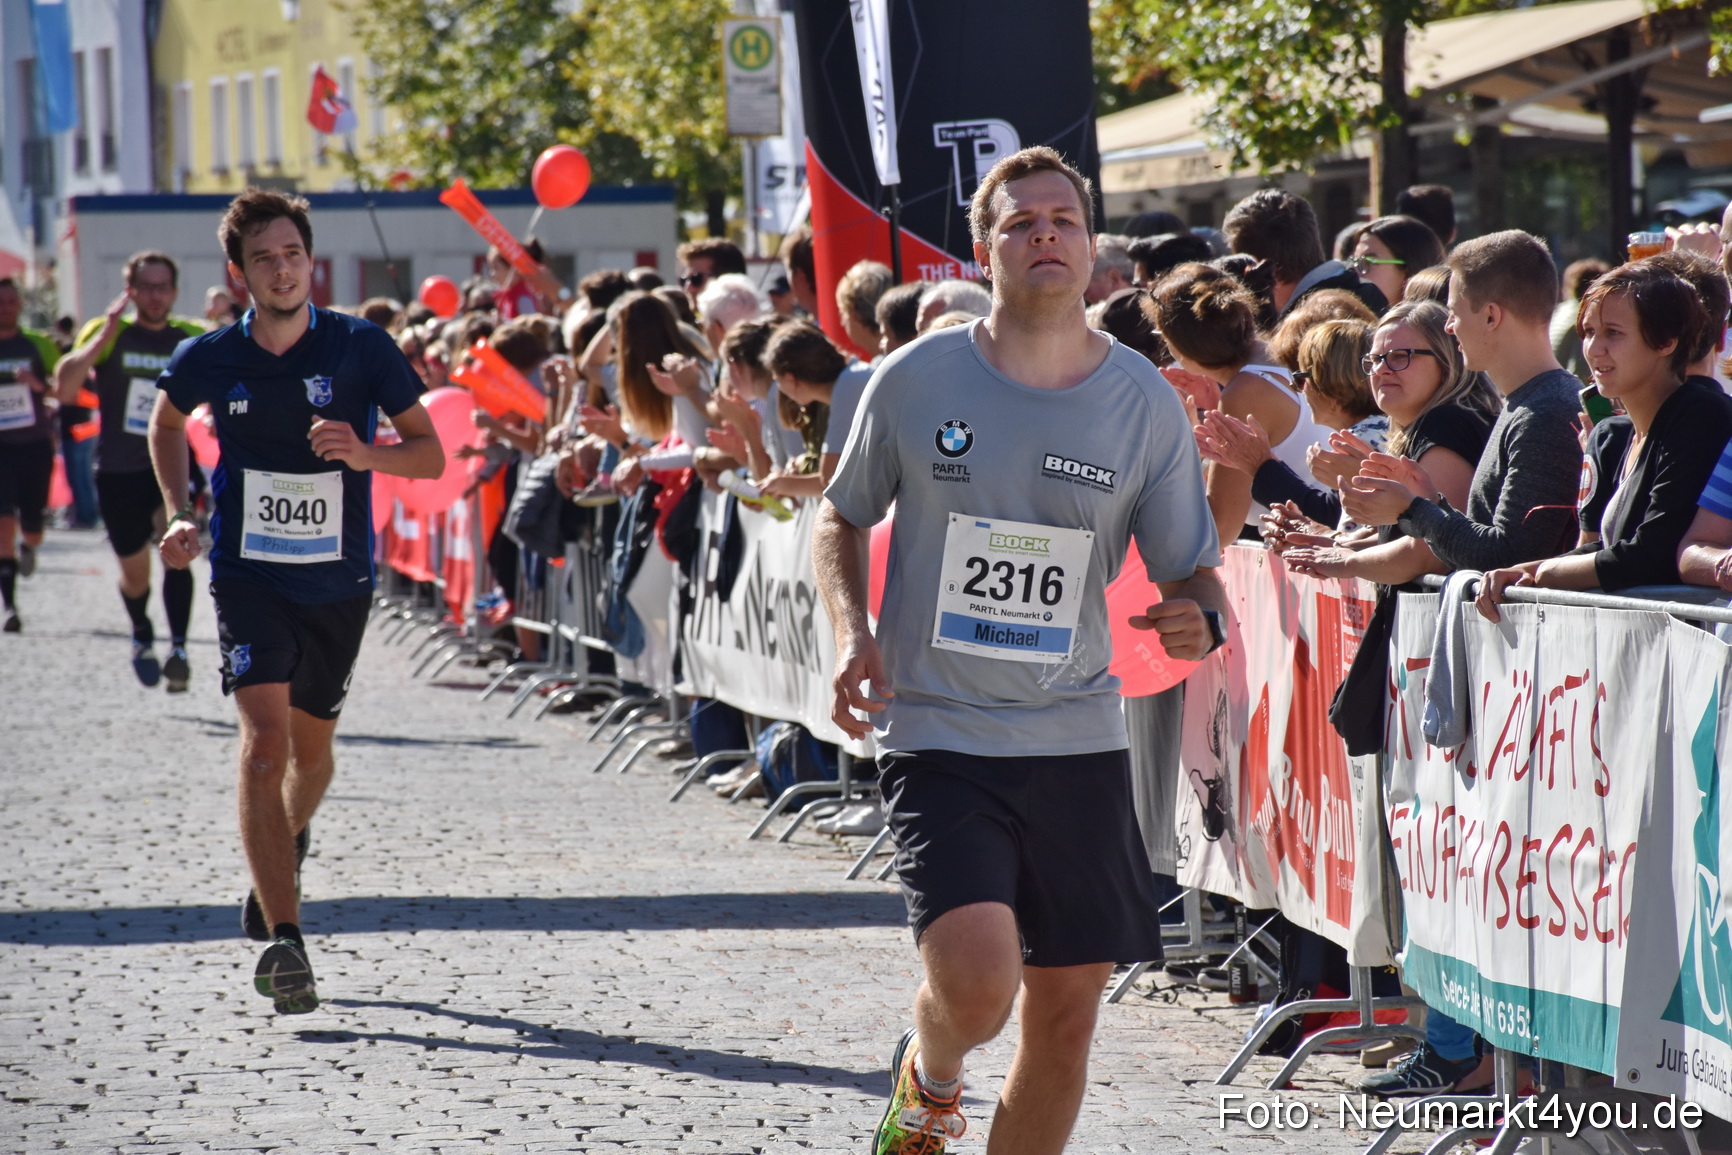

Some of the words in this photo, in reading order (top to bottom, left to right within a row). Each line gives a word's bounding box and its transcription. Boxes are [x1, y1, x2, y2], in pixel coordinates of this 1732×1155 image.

[917, 262, 957, 281] THE
[229, 400, 249, 415] PM
[940, 420, 973, 436] BMW
[932, 463, 971, 476] PARTL
[933, 473, 971, 484] Neumarkt
[1043, 453, 1116, 488] BOCK
[272, 479, 315, 492] BOCK
[1041, 471, 1064, 481] inspired
[1065, 476, 1074, 484] by
[1073, 479, 1091, 488] smart
[1090, 484, 1114, 495] concepts
[258, 495, 327, 526] 3040
[990, 533, 1051, 552] BOCK
[962, 556, 1065, 607] 2316
[969, 603, 999, 616] PARTL
[1000, 609, 1041, 620] Neumarkt
[974, 622, 1041, 648] Michael
[1656, 1039, 1689, 1076] Jura
